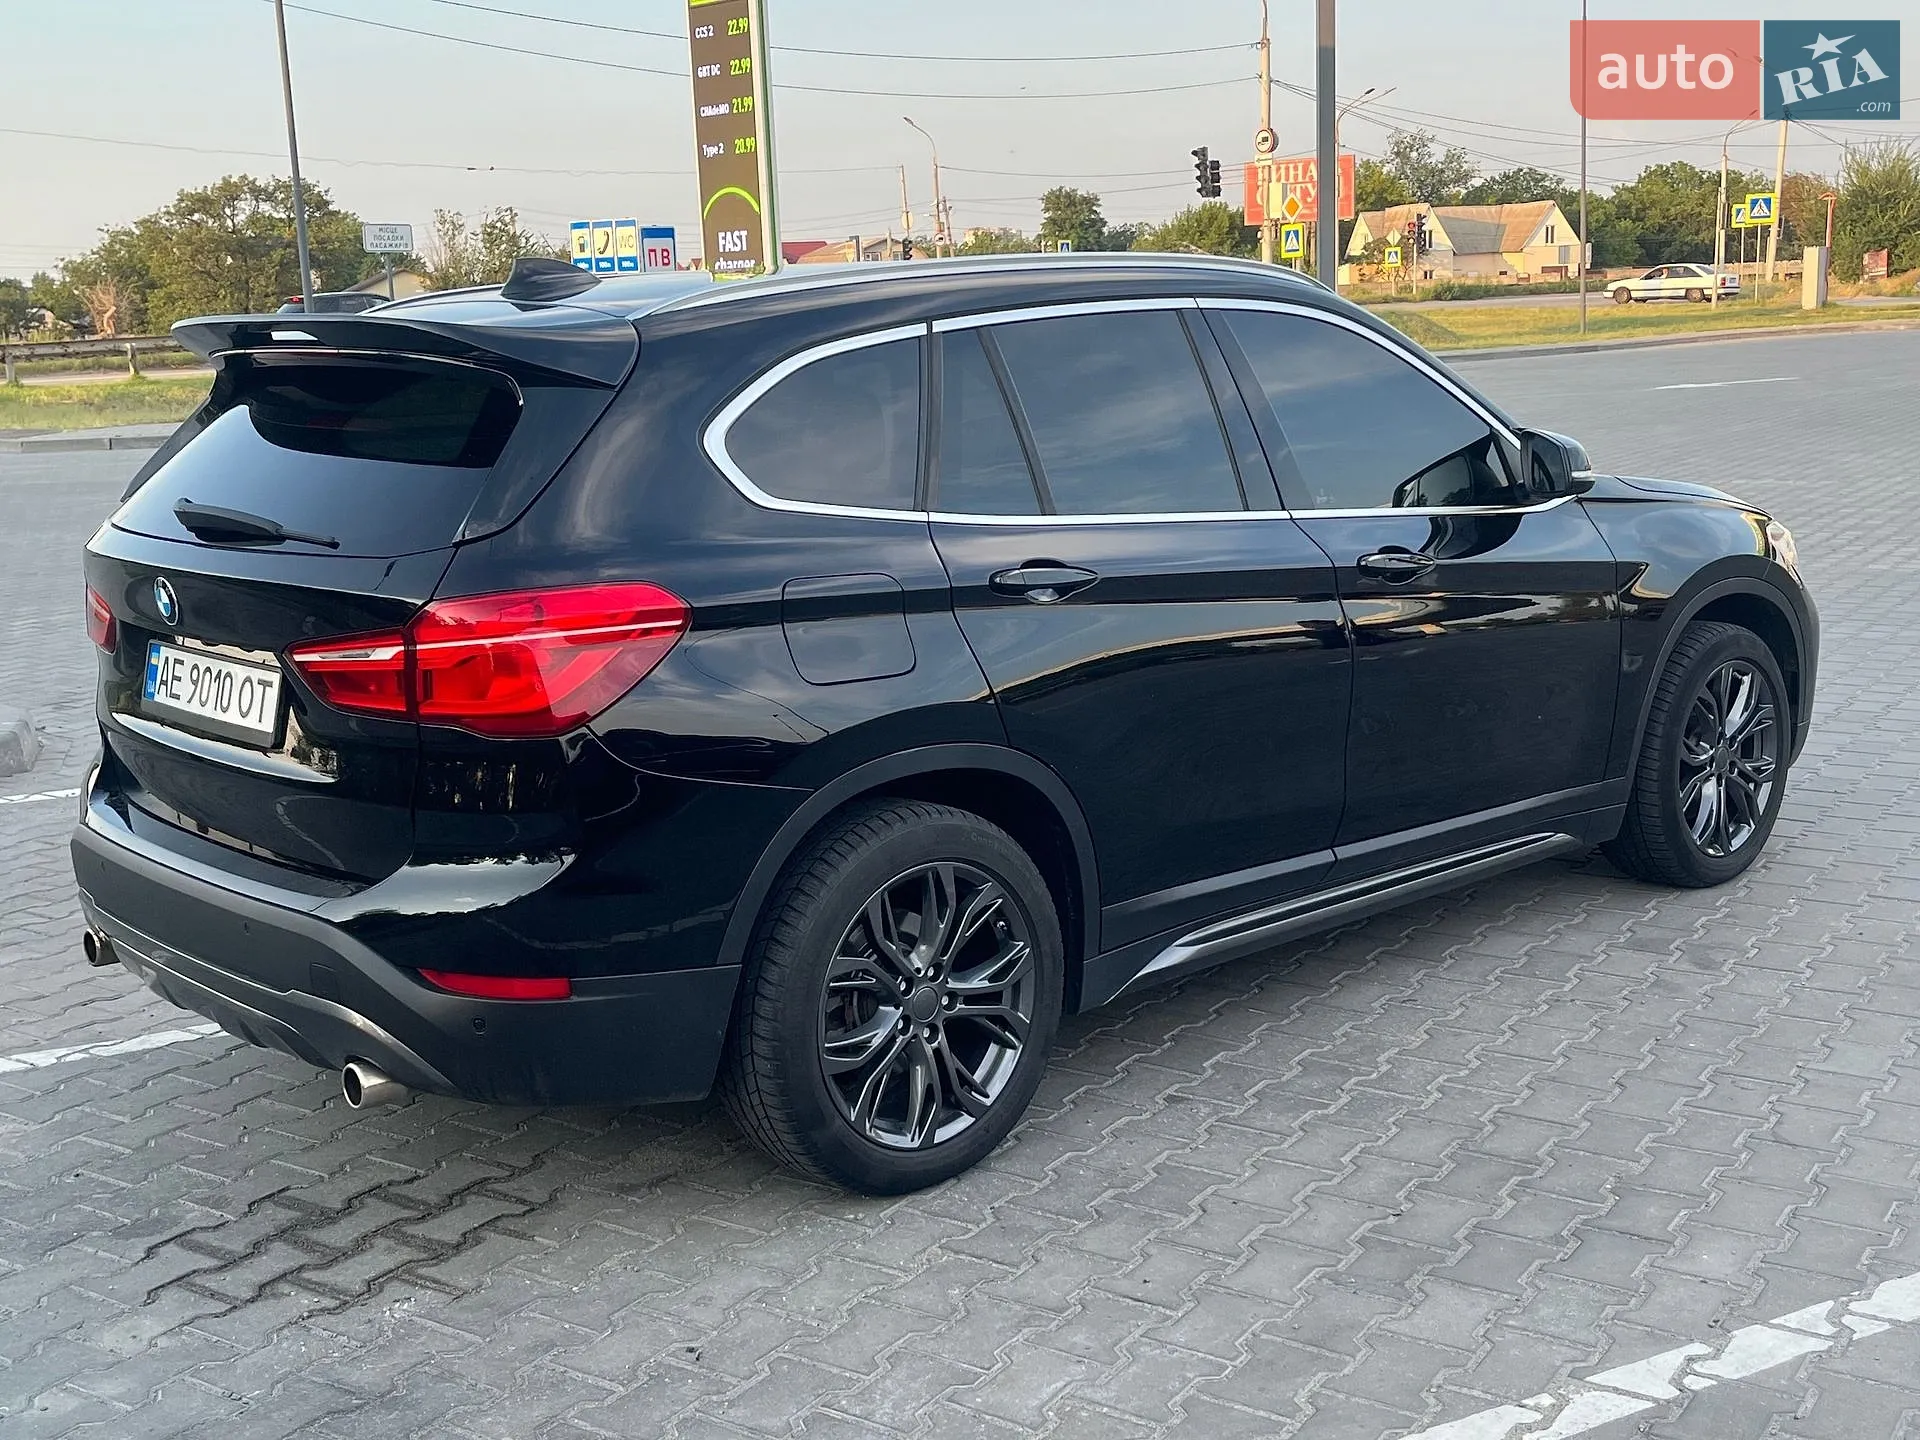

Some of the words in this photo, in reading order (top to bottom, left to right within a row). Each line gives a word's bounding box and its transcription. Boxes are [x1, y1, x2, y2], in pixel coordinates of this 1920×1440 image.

[695, 26, 708, 39] CCS
[709, 25, 714, 37] 2
[727, 17, 749, 36] 22.99
[712, 64, 721, 76] DC
[730, 57, 751, 76] 22.99
[700, 103, 730, 117] CHAdeMO
[732, 96, 753, 114] 21.99
[702, 144, 719, 158] Type
[719, 142, 725, 154] 2
[735, 136, 756, 154] 20.99
[718, 230, 748, 253] FAST
[157, 655, 185, 701] AE
[187, 663, 233, 714] 9010
[238, 678, 273, 723] OT
